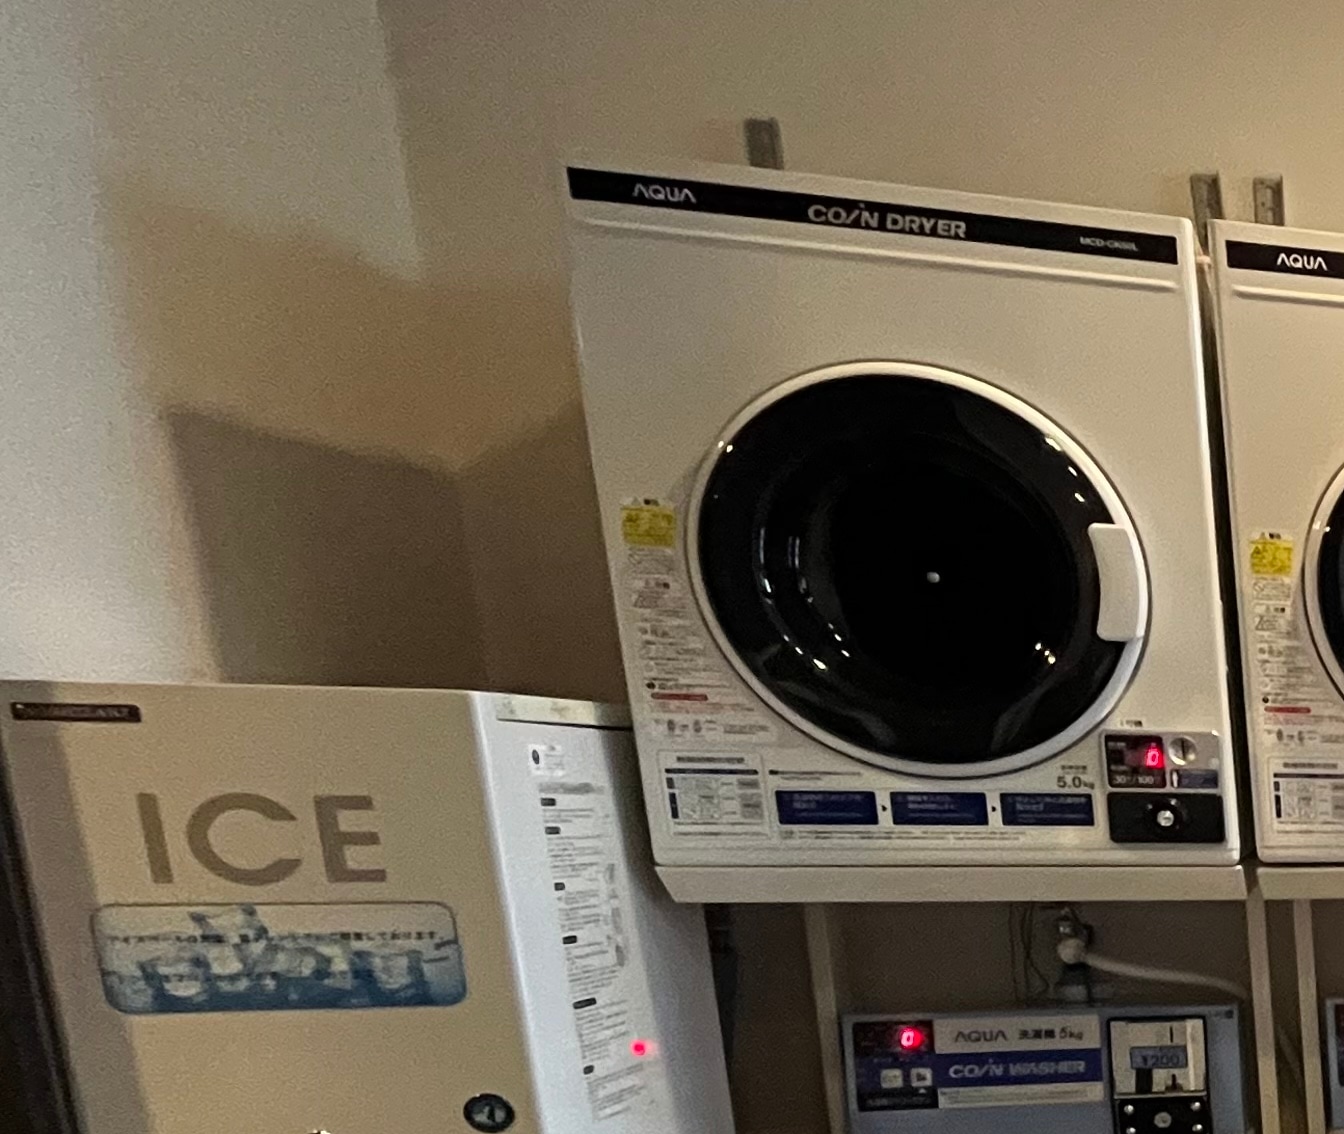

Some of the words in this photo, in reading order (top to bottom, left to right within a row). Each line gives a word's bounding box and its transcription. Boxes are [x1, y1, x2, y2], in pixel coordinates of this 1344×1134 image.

[632, 183, 697, 204] AQUA
[885, 212, 968, 239] DRYER
[1276, 251, 1328, 272] AQUA
[135, 791, 388, 887] ICE
[954, 1029, 1008, 1043] AQUA
